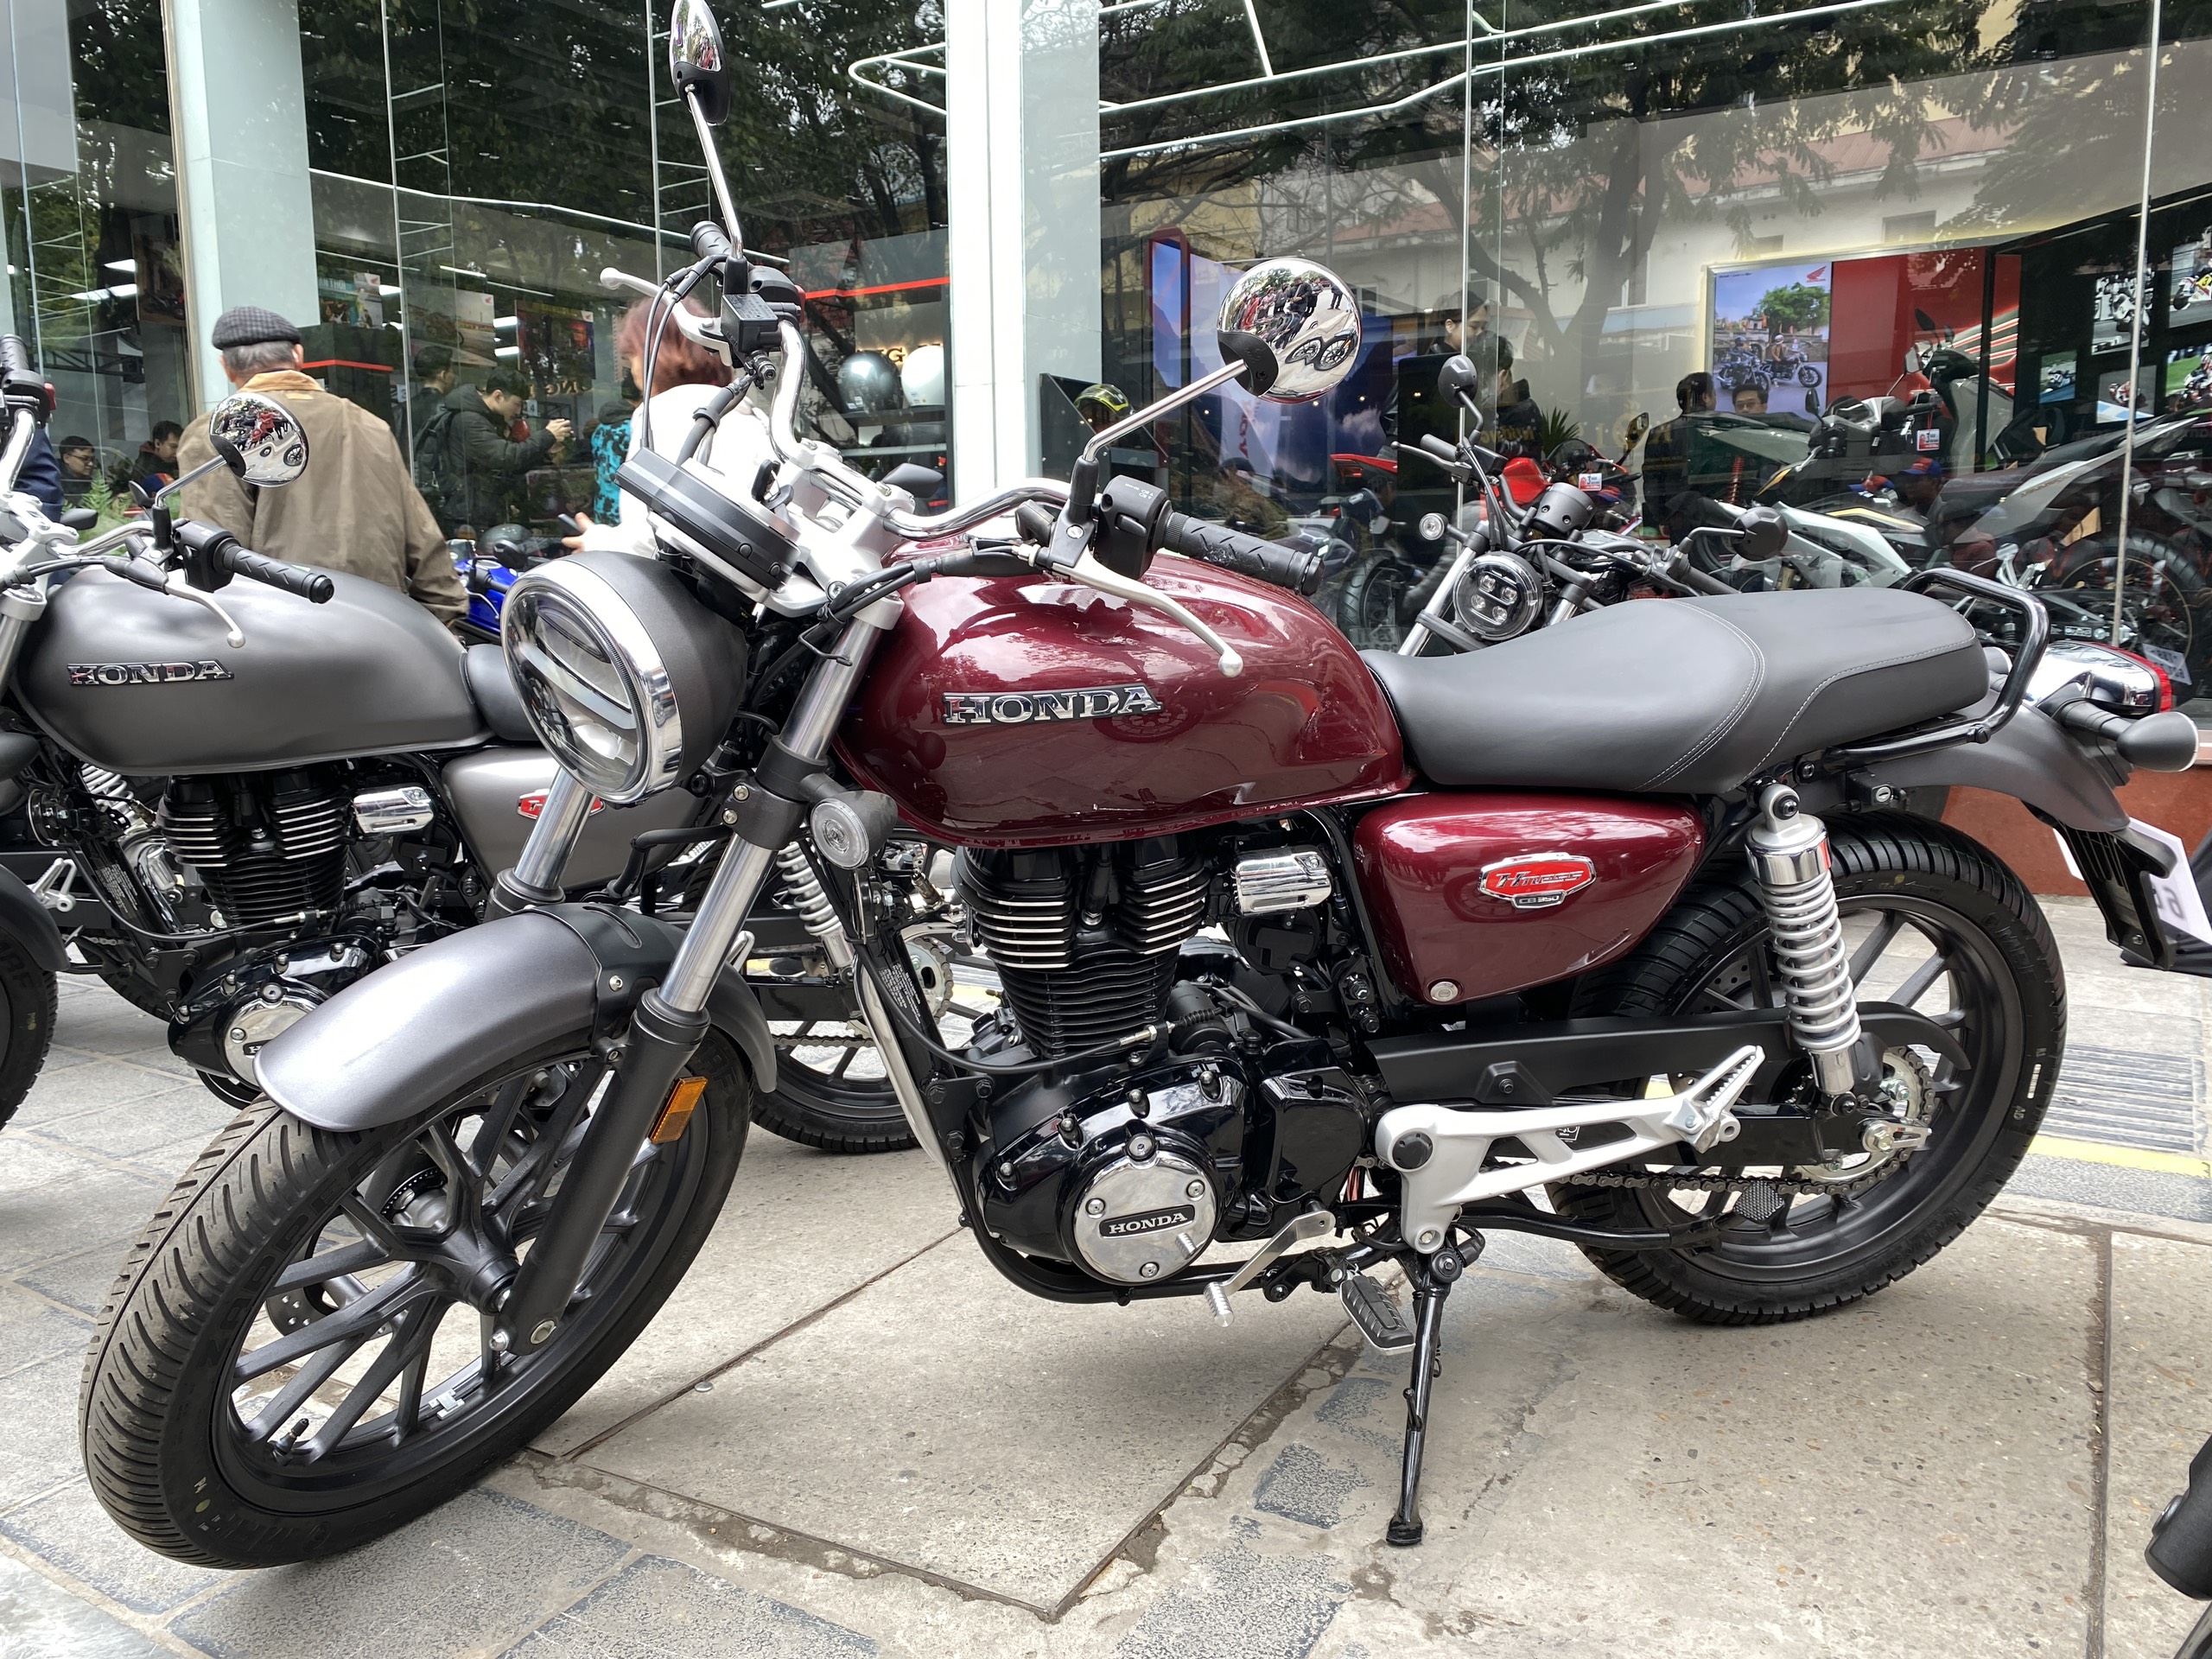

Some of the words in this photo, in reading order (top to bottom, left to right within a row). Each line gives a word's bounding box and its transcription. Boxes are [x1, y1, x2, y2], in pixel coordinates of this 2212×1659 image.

[67, 659, 232, 685] HONDA
[944, 685, 1163, 723] HONDA
[1109, 1212, 1187, 1235] HONDA
